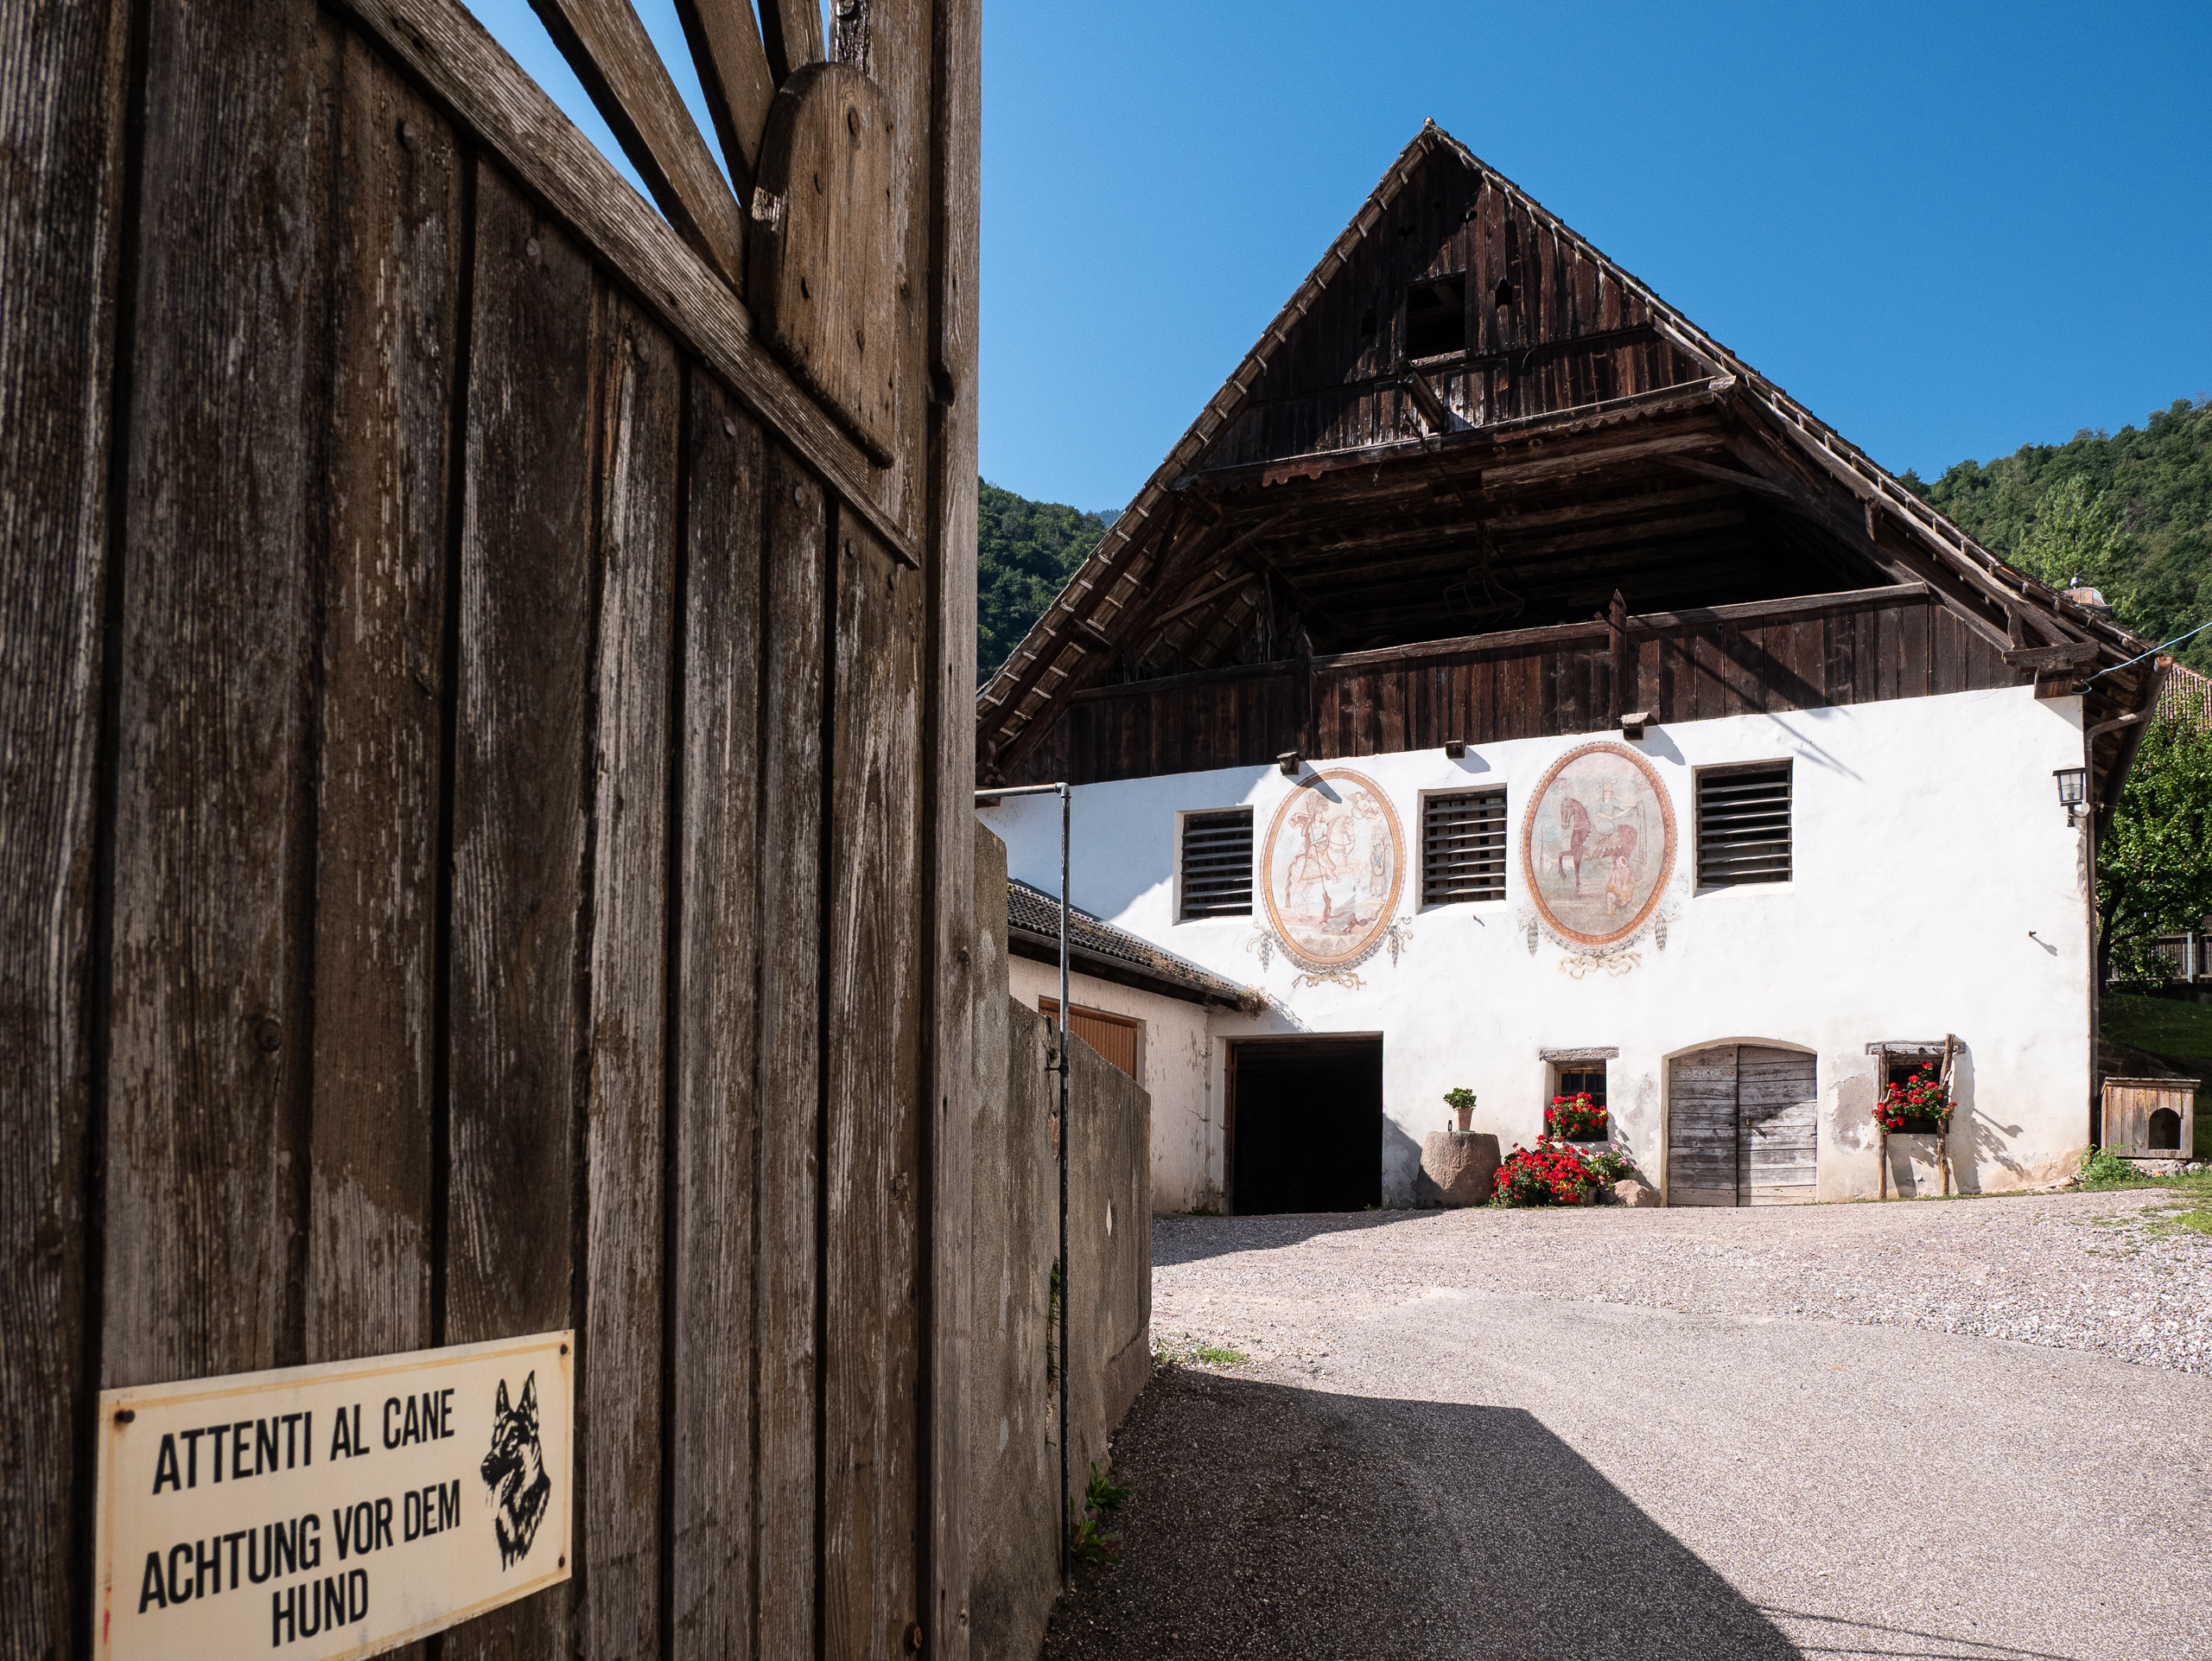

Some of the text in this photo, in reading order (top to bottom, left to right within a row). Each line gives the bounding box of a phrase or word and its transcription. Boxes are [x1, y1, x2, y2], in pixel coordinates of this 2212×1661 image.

[152, 1388, 454, 1495] ATTENTI AL CANE
[137, 1479, 461, 1614] ACHTUNG VOR DEM
[272, 1568, 369, 1648] HUND
